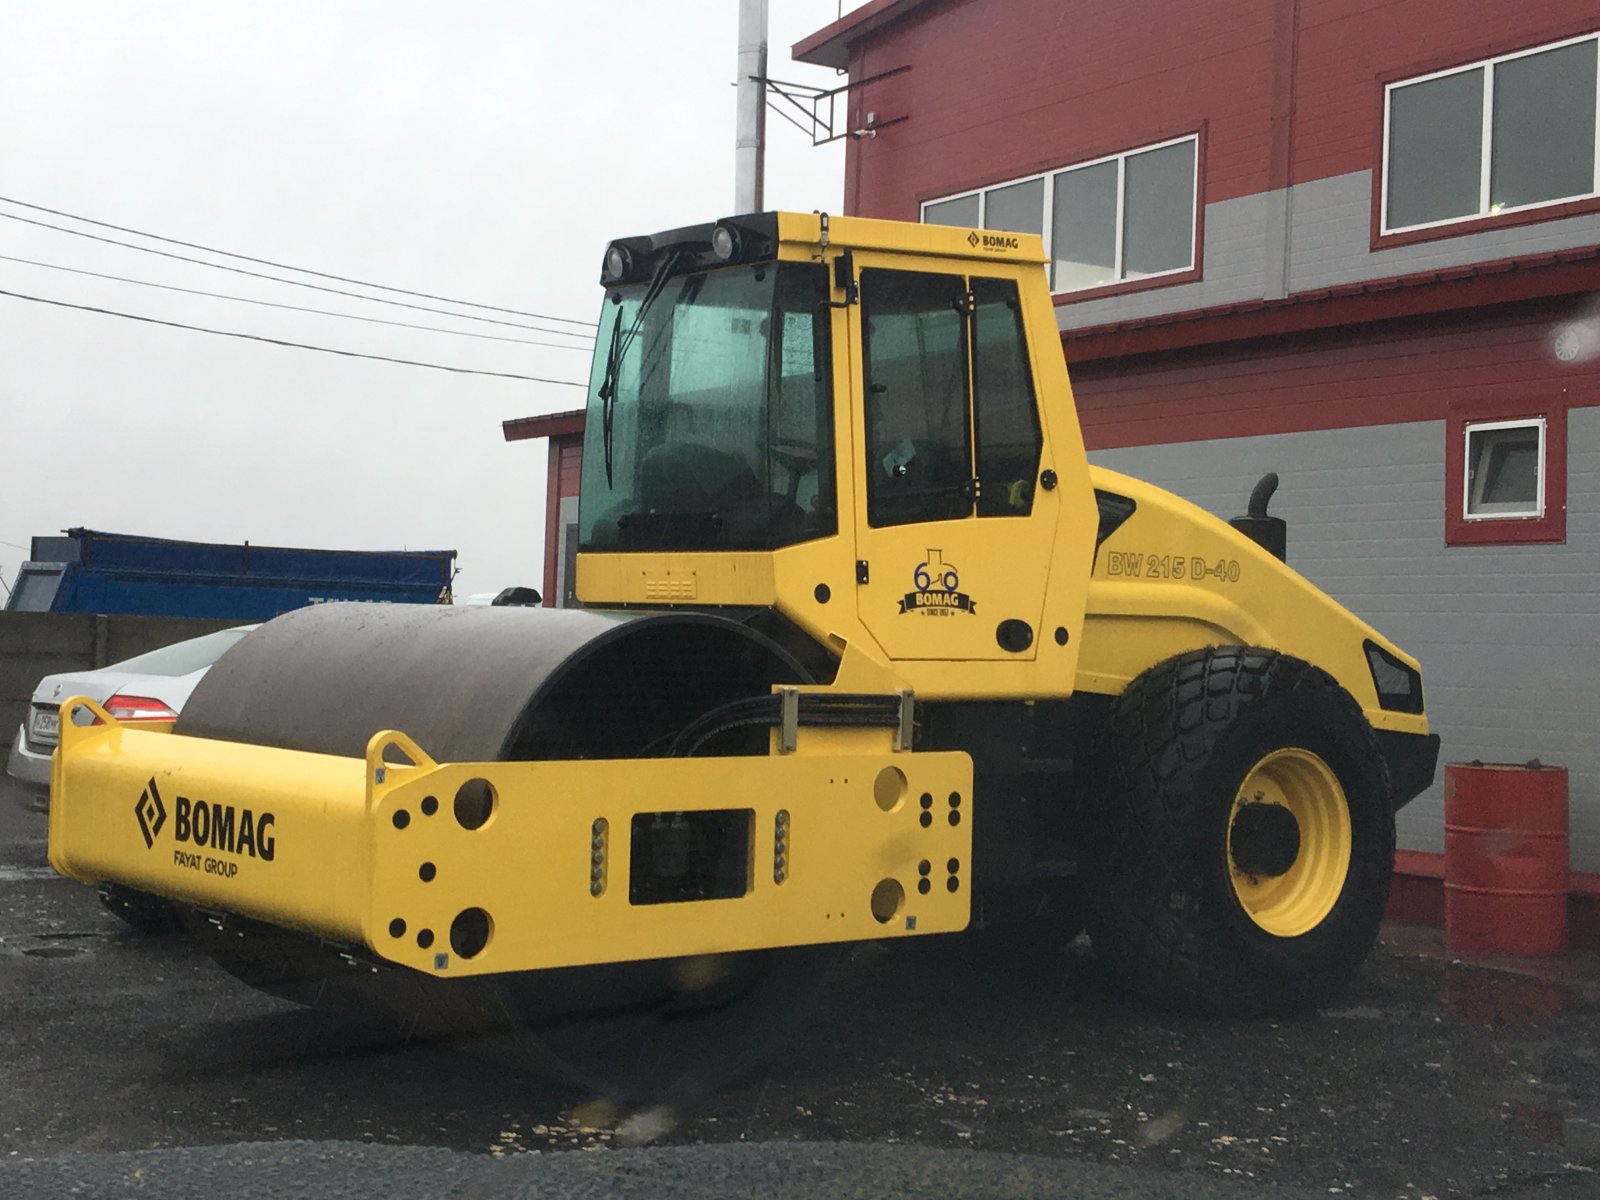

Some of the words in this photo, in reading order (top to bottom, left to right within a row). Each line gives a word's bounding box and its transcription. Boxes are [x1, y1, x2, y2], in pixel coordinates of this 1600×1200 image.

[982, 235, 1018, 249] BOMAG
[1107, 551, 1144, 577] BW
[1146, 554, 1185, 579] 215
[1190, 557, 1240, 582] D-40
[915, 592, 959, 606] BOMAG
[175, 796, 275, 862] BOMAG
[174, 850, 202, 871] FAYAT
[204, 857, 238, 879] GROUP
